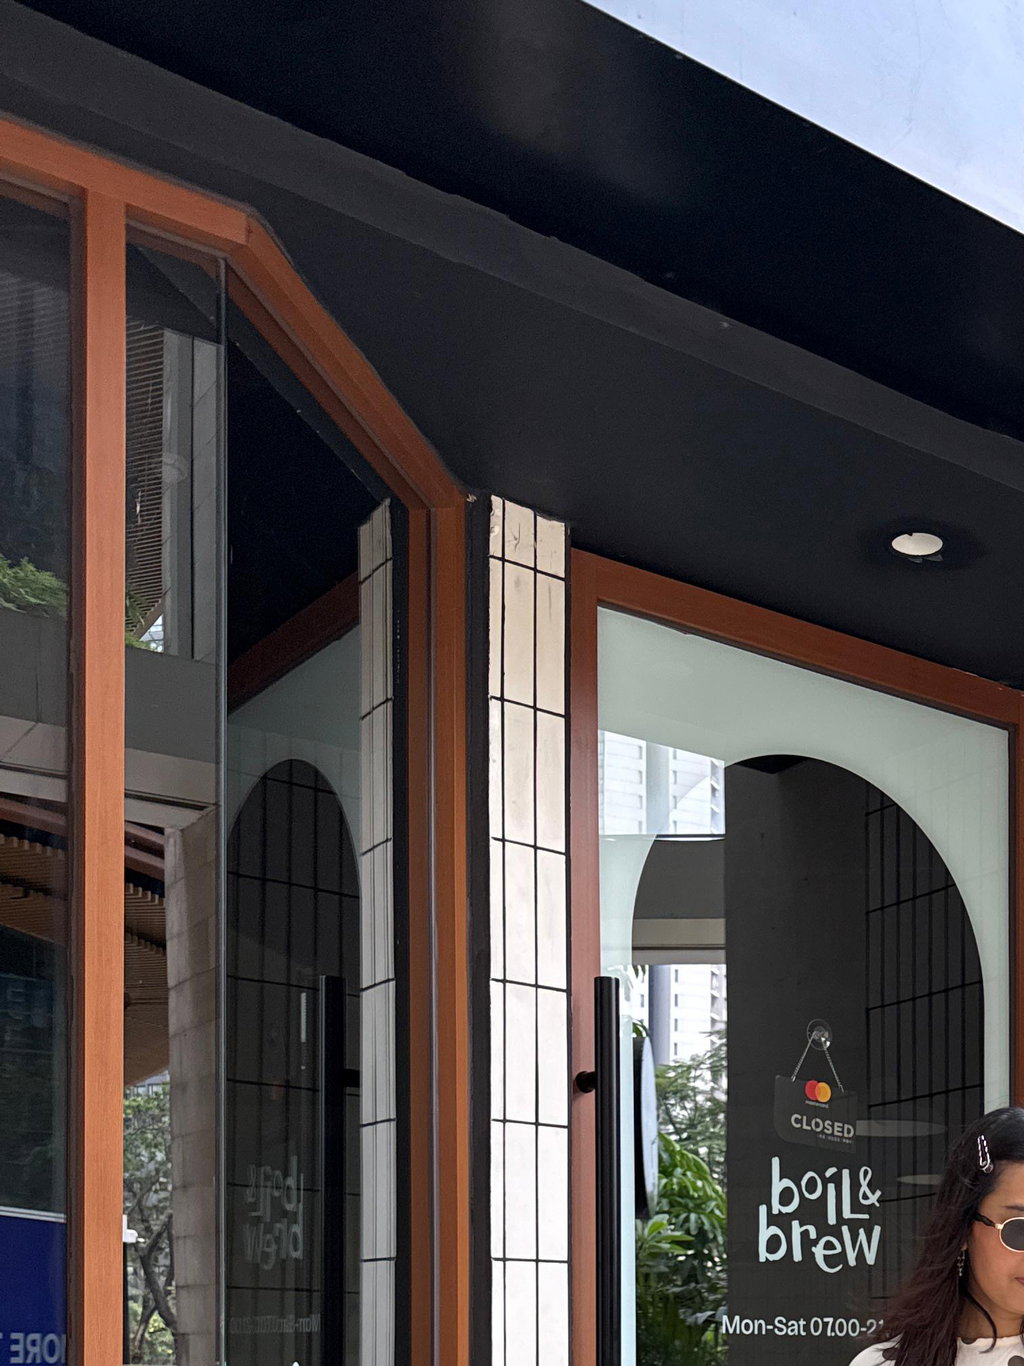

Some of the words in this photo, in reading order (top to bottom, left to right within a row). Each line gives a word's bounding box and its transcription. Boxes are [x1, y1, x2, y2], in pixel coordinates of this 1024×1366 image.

[790, 1113, 855, 1138] CLOSED
[758, 1203, 881, 1273] brew
[721, 1314, 807, 1336] Mon-Sat
